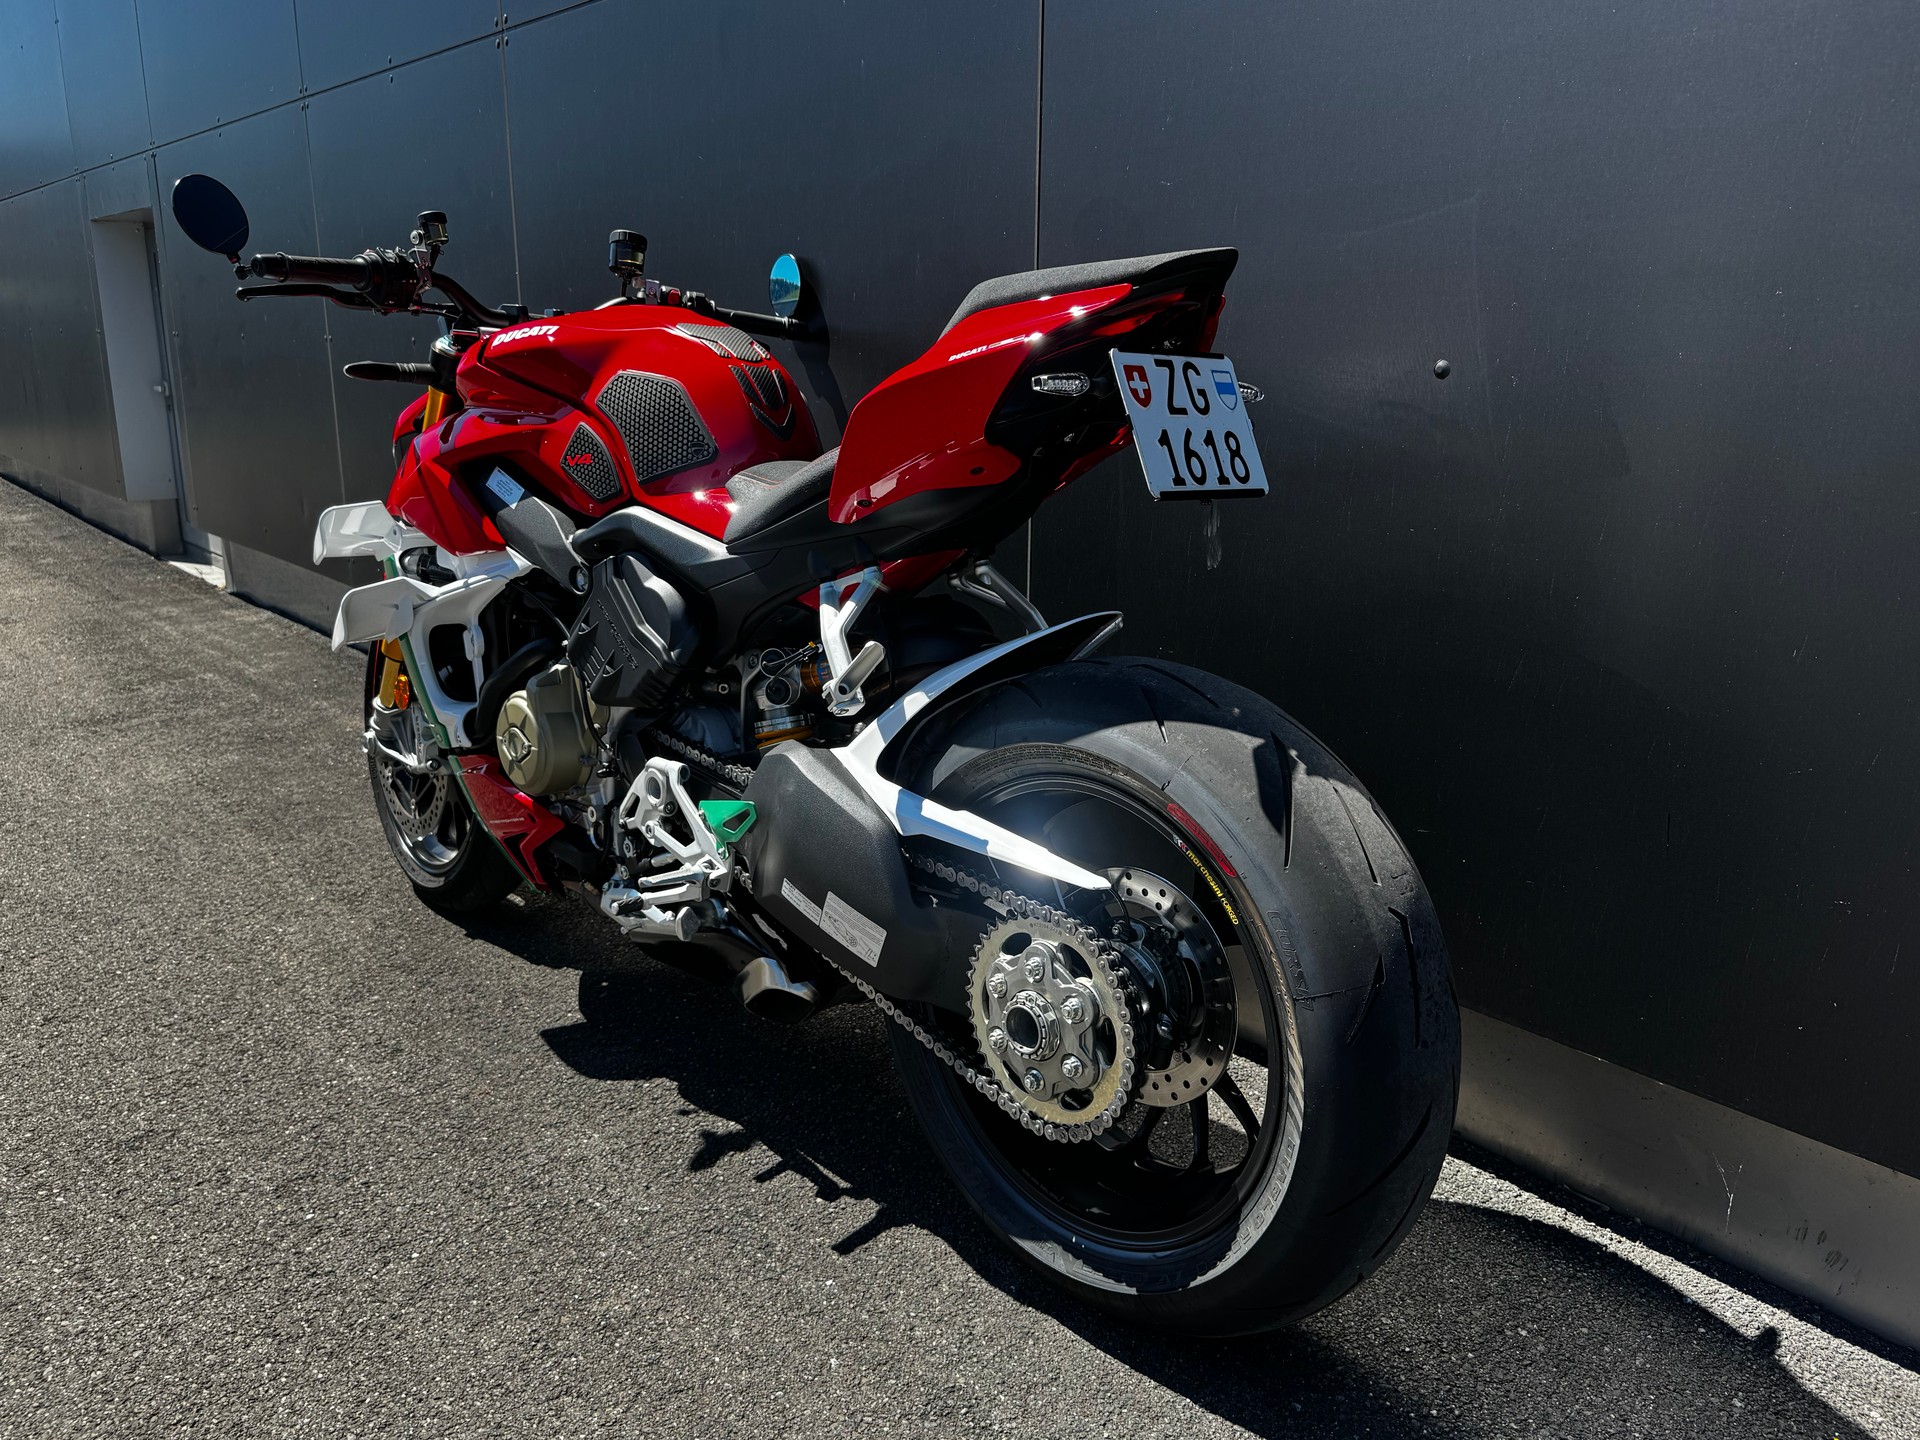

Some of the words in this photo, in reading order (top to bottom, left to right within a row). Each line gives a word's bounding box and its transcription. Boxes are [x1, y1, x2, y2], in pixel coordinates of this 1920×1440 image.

[491, 325, 560, 347] DUCATI
[948, 345, 988, 361] DUCATI
[1154, 359, 1210, 415] ZG
[566, 454, 593, 467] V4
[1158, 428, 1250, 486] 1618
[1185, 850, 1224, 898] marchesini
[1221, 897, 1239, 925] FORGED
[1266, 910, 1314, 1011] CORSA
